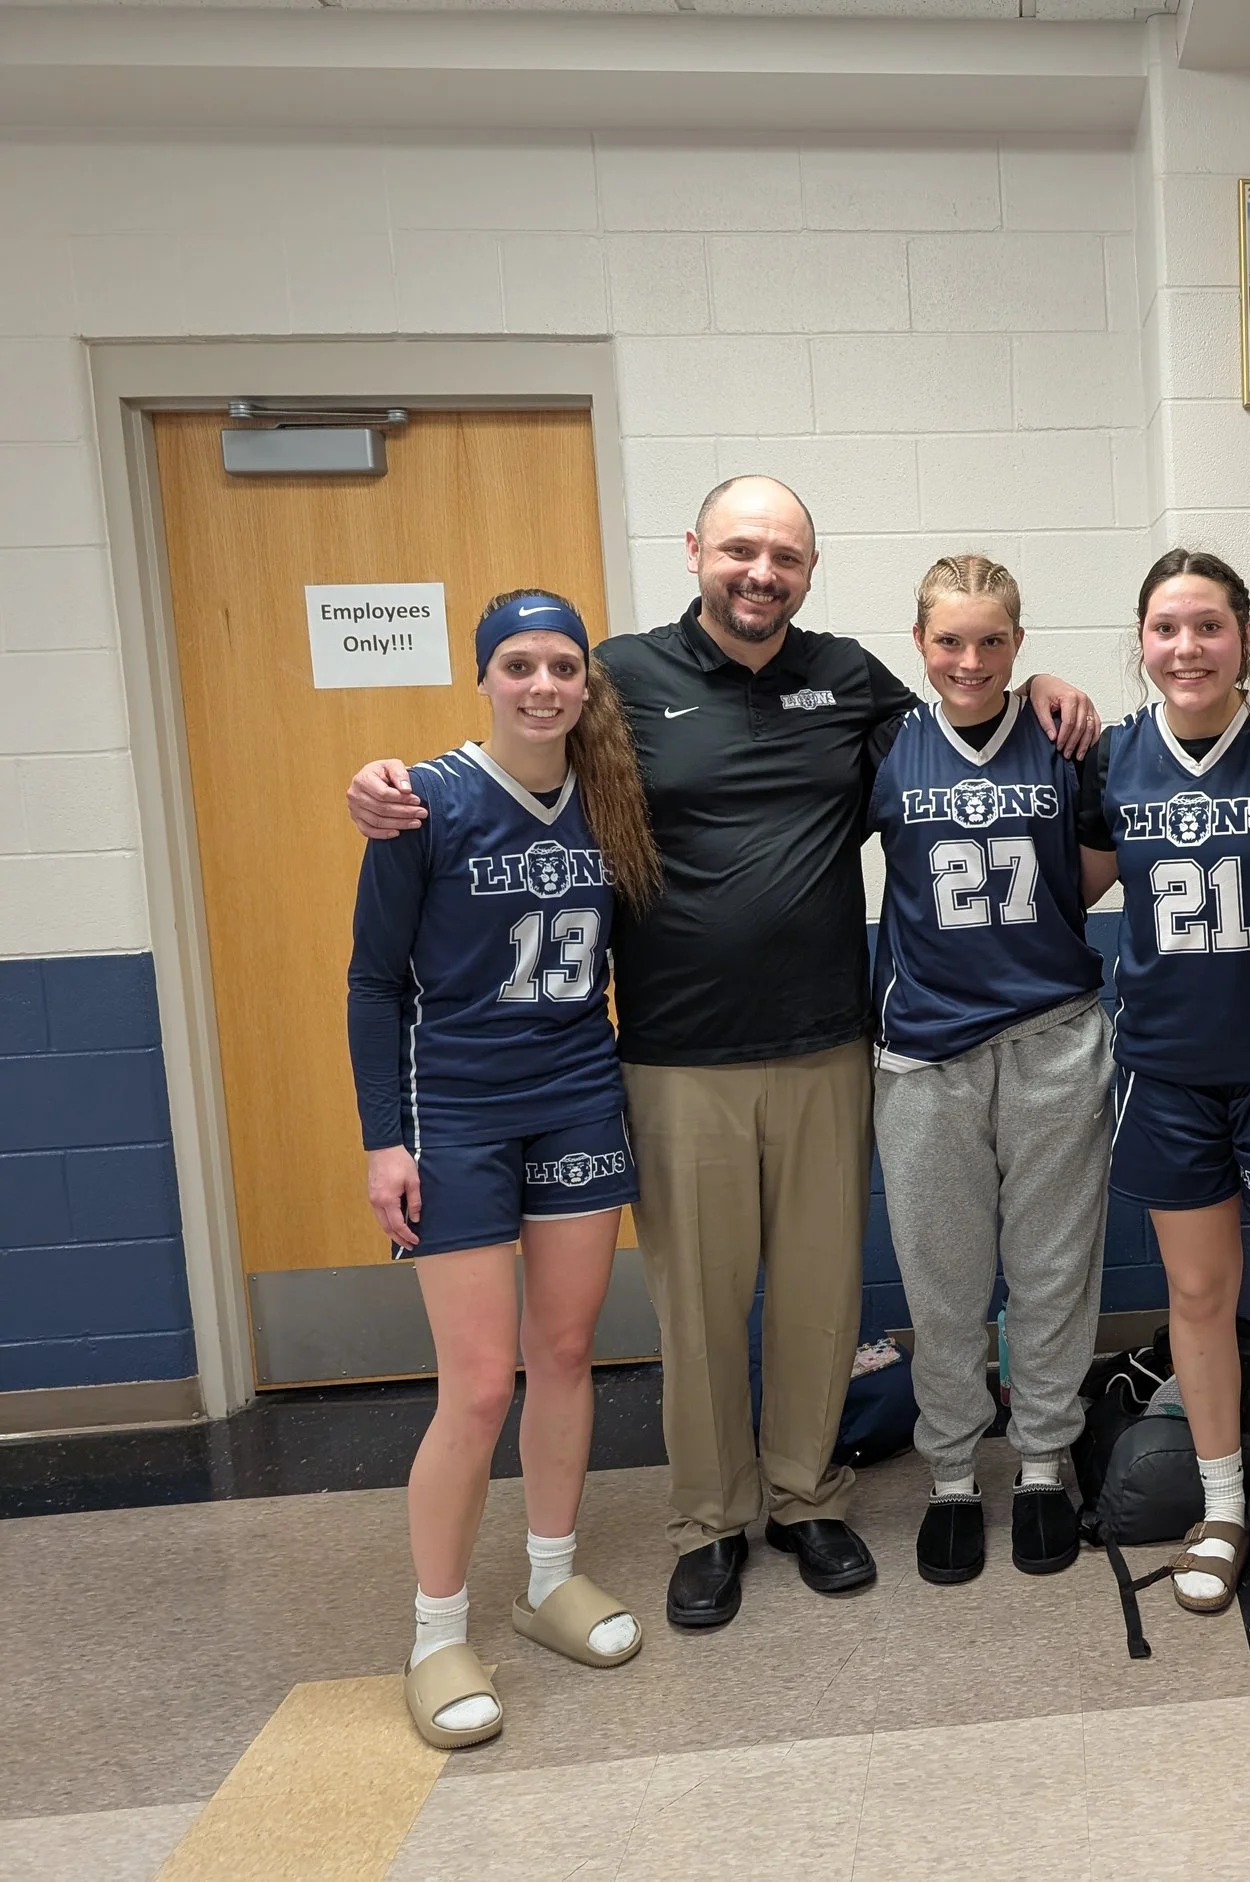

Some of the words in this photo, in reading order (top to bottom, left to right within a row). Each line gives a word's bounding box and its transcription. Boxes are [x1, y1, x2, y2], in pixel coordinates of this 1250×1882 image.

[320, 602, 431, 624] Employees
[343, 633, 413, 655] Only!!!
[929, 836, 1039, 930] 27
[496, 907, 601, 1002] 13
